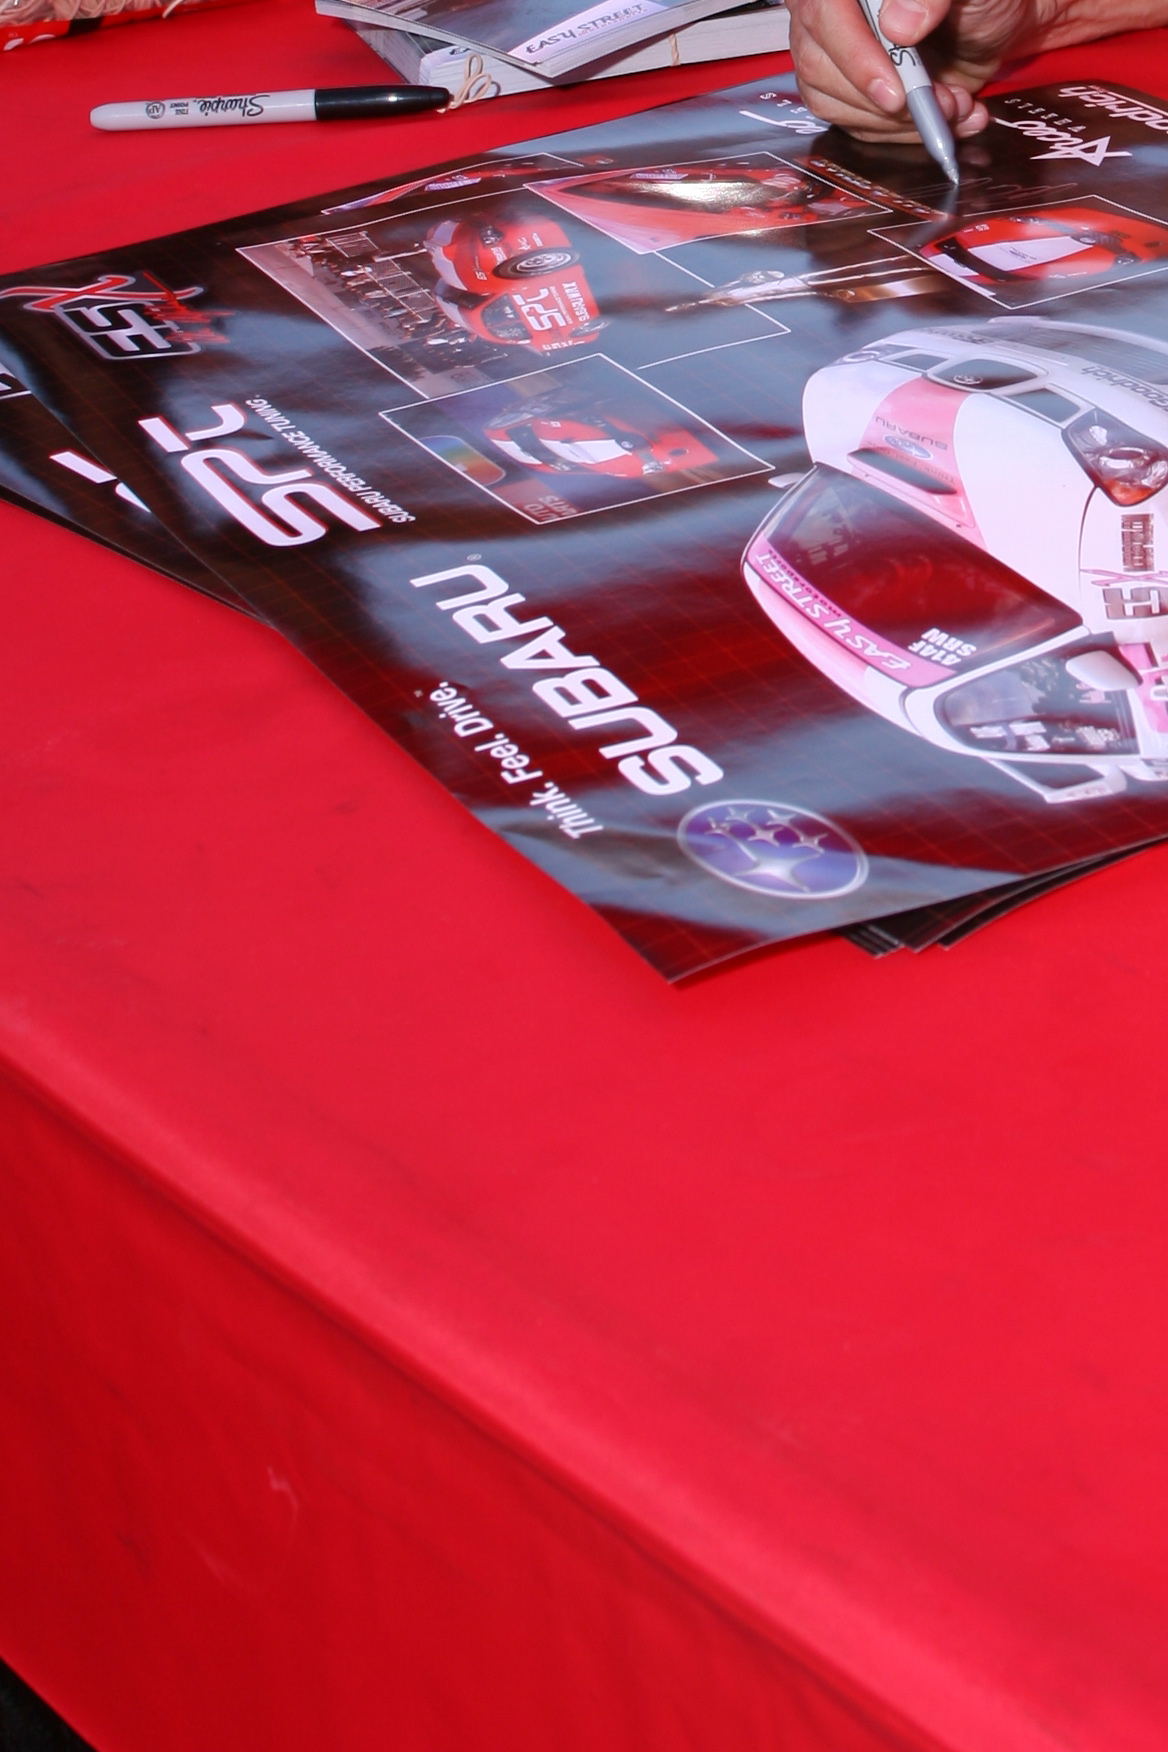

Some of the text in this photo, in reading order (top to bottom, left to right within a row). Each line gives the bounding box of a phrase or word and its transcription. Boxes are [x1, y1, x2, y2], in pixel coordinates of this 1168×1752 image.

[576, 2, 648, 36] STREET
[195, 93, 270, 117] Sharpie
[875, 414, 949, 452] SUBARU
[281, 429, 372, 497] PERFORMANCE
[360, 489, 417, 524] SUBARU
[754, 551, 912, 671] EASY STREET
[409, 563, 725, 796] SUBARU
[429, 680, 604, 840] Think. Feel. Drive.
